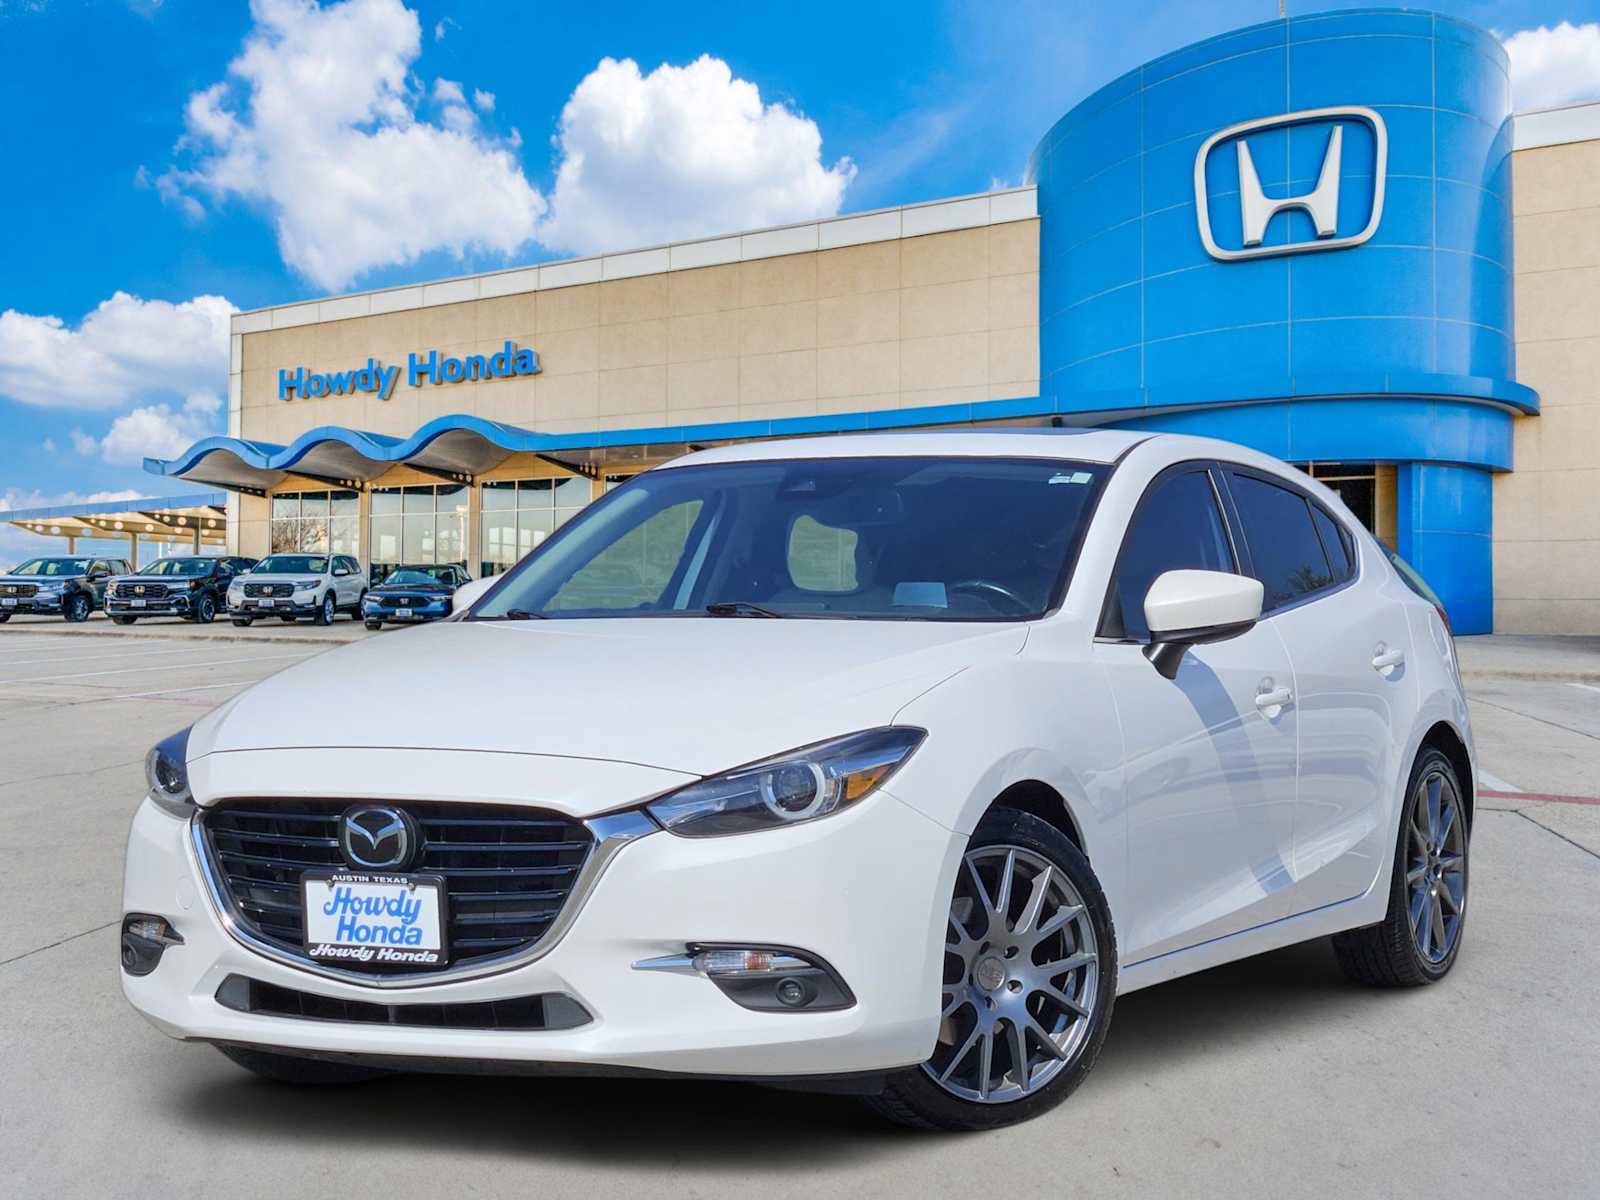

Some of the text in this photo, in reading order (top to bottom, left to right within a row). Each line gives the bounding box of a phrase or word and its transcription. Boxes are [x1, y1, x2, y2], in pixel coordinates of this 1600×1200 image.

[278, 340, 542, 400] Howdy Honda
[331, 874, 370, 882] AUSTIN
[323, 887, 422, 925] Howdy
[336, 916, 423, 945] Honda
[309, 944, 439, 963] Howdy Honda
